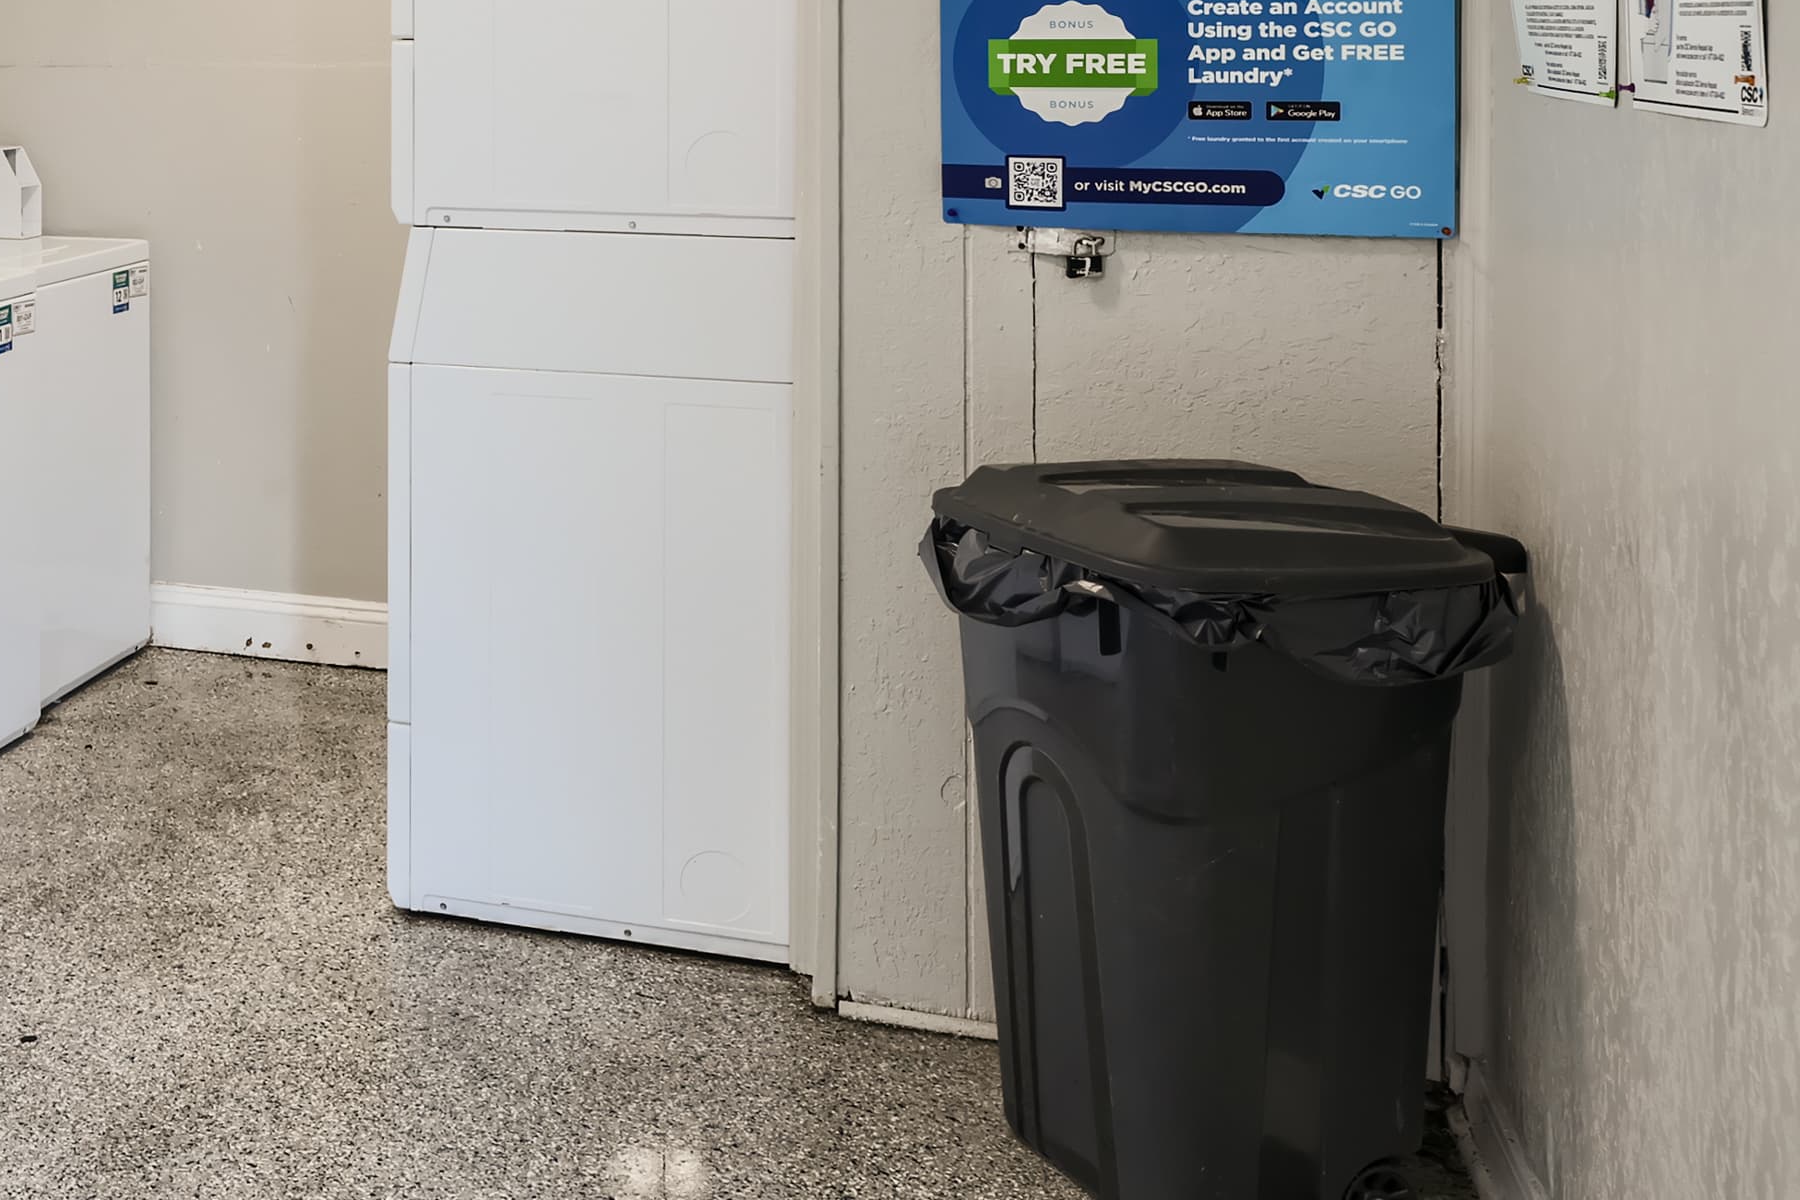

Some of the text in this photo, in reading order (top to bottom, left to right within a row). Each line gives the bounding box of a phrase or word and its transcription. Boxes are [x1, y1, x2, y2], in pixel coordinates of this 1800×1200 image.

[1187, 0, 1263, 15] Create
[1269, 1, 1298, 15] an
[1049, 20, 1094, 29] BONUS
[1187, 21, 1397, 41] Using the CSC GO
[1187, 44, 1405, 64] App and Get FREE
[996, 53, 1147, 75] TRY FREE
[1741, 86, 1758, 103] CSC
[1049, 100, 1094, 109] BONUS
[1206, 108, 1247, 118] App Store
[1287, 108, 1336, 119] Google Play
[1074, 180, 1246, 194] or visit MyCSCGO.com
[1333, 184, 1421, 199] CSC GO
[115, 290, 122, 303] 12
